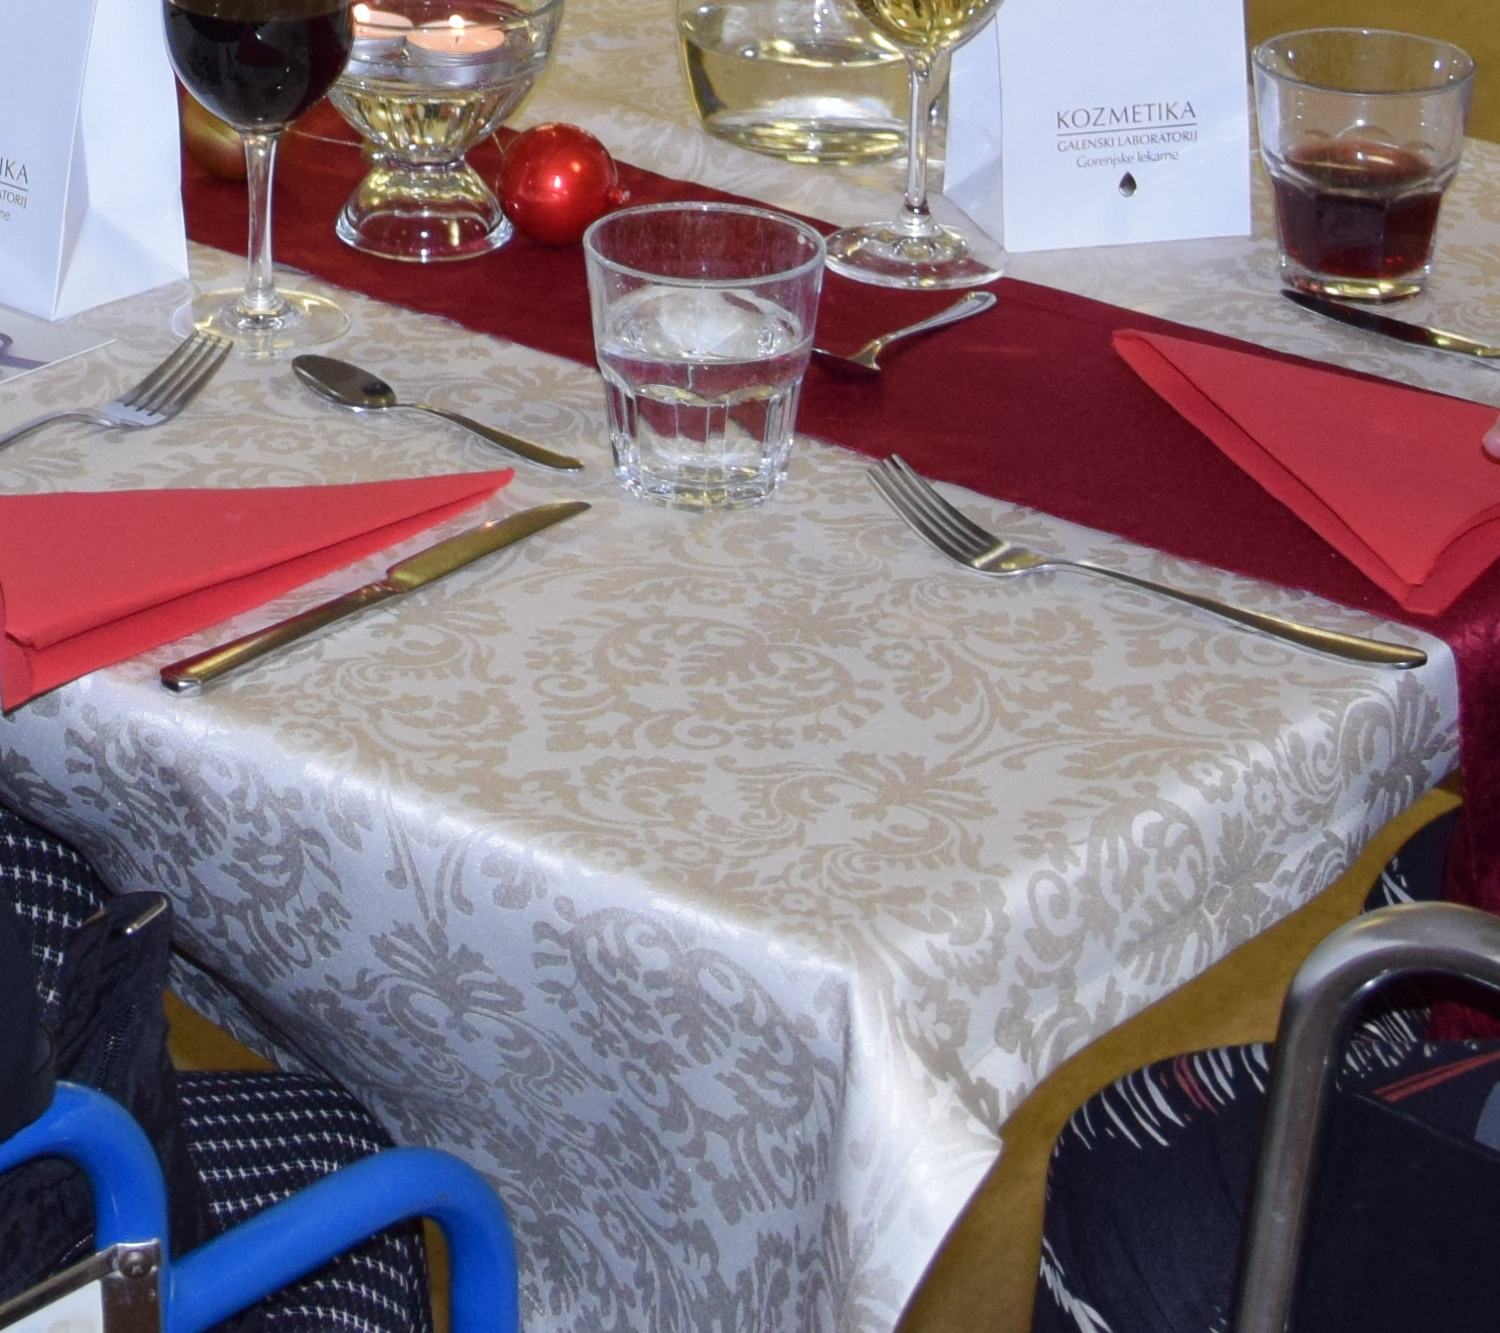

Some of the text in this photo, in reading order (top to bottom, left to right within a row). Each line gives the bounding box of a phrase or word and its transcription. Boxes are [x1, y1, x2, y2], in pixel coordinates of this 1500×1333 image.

[1057, 101, 1196, 129] KOZMETIKA
[1057, 130, 1198, 152] GALENSKI LABORATORIJ
[1076, 149, 1179, 168] Gorenjske lekarne
